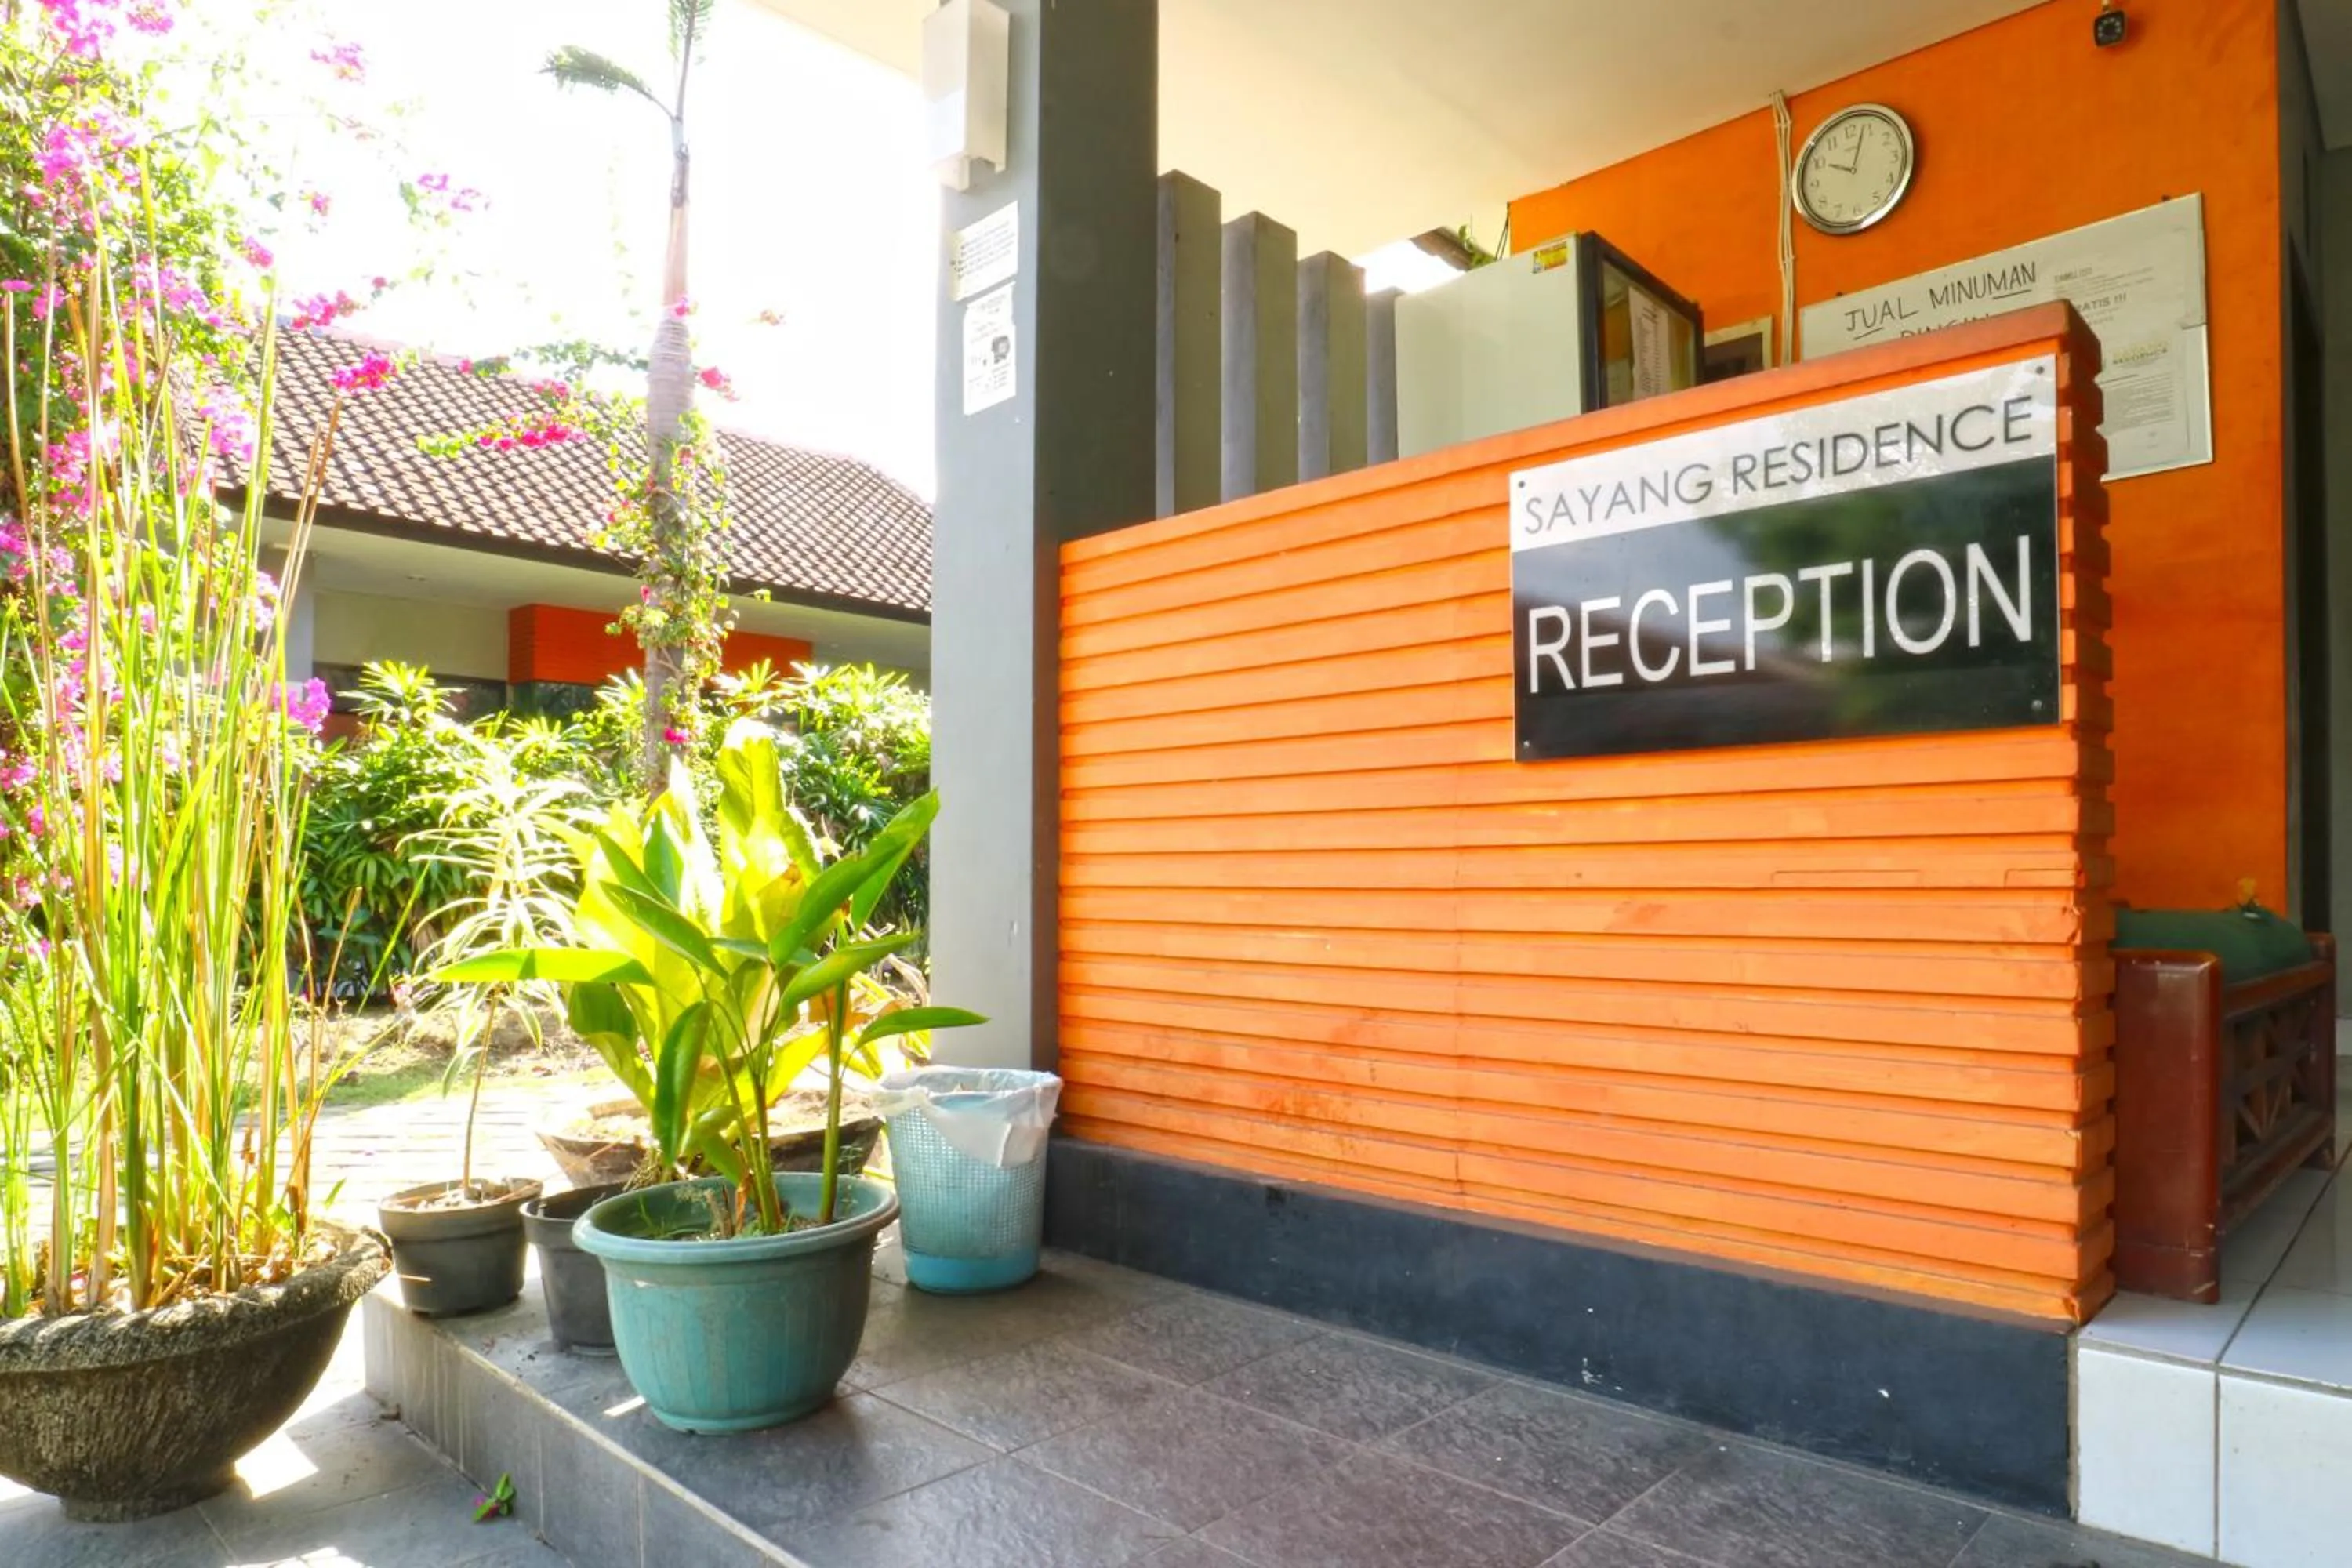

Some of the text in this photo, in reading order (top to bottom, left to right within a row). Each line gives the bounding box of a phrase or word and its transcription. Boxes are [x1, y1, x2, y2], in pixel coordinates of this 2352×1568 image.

[1844, 123, 1857, 139] 12
[1844, 296, 1919, 332] JUAL
[1928, 261, 2036, 309] MINUMAN
[1525, 463, 1713, 535] SAYANG
[1732, 395, 2033, 495] RESIDENCE
[1528, 535, 2032, 694] RECEPTION
